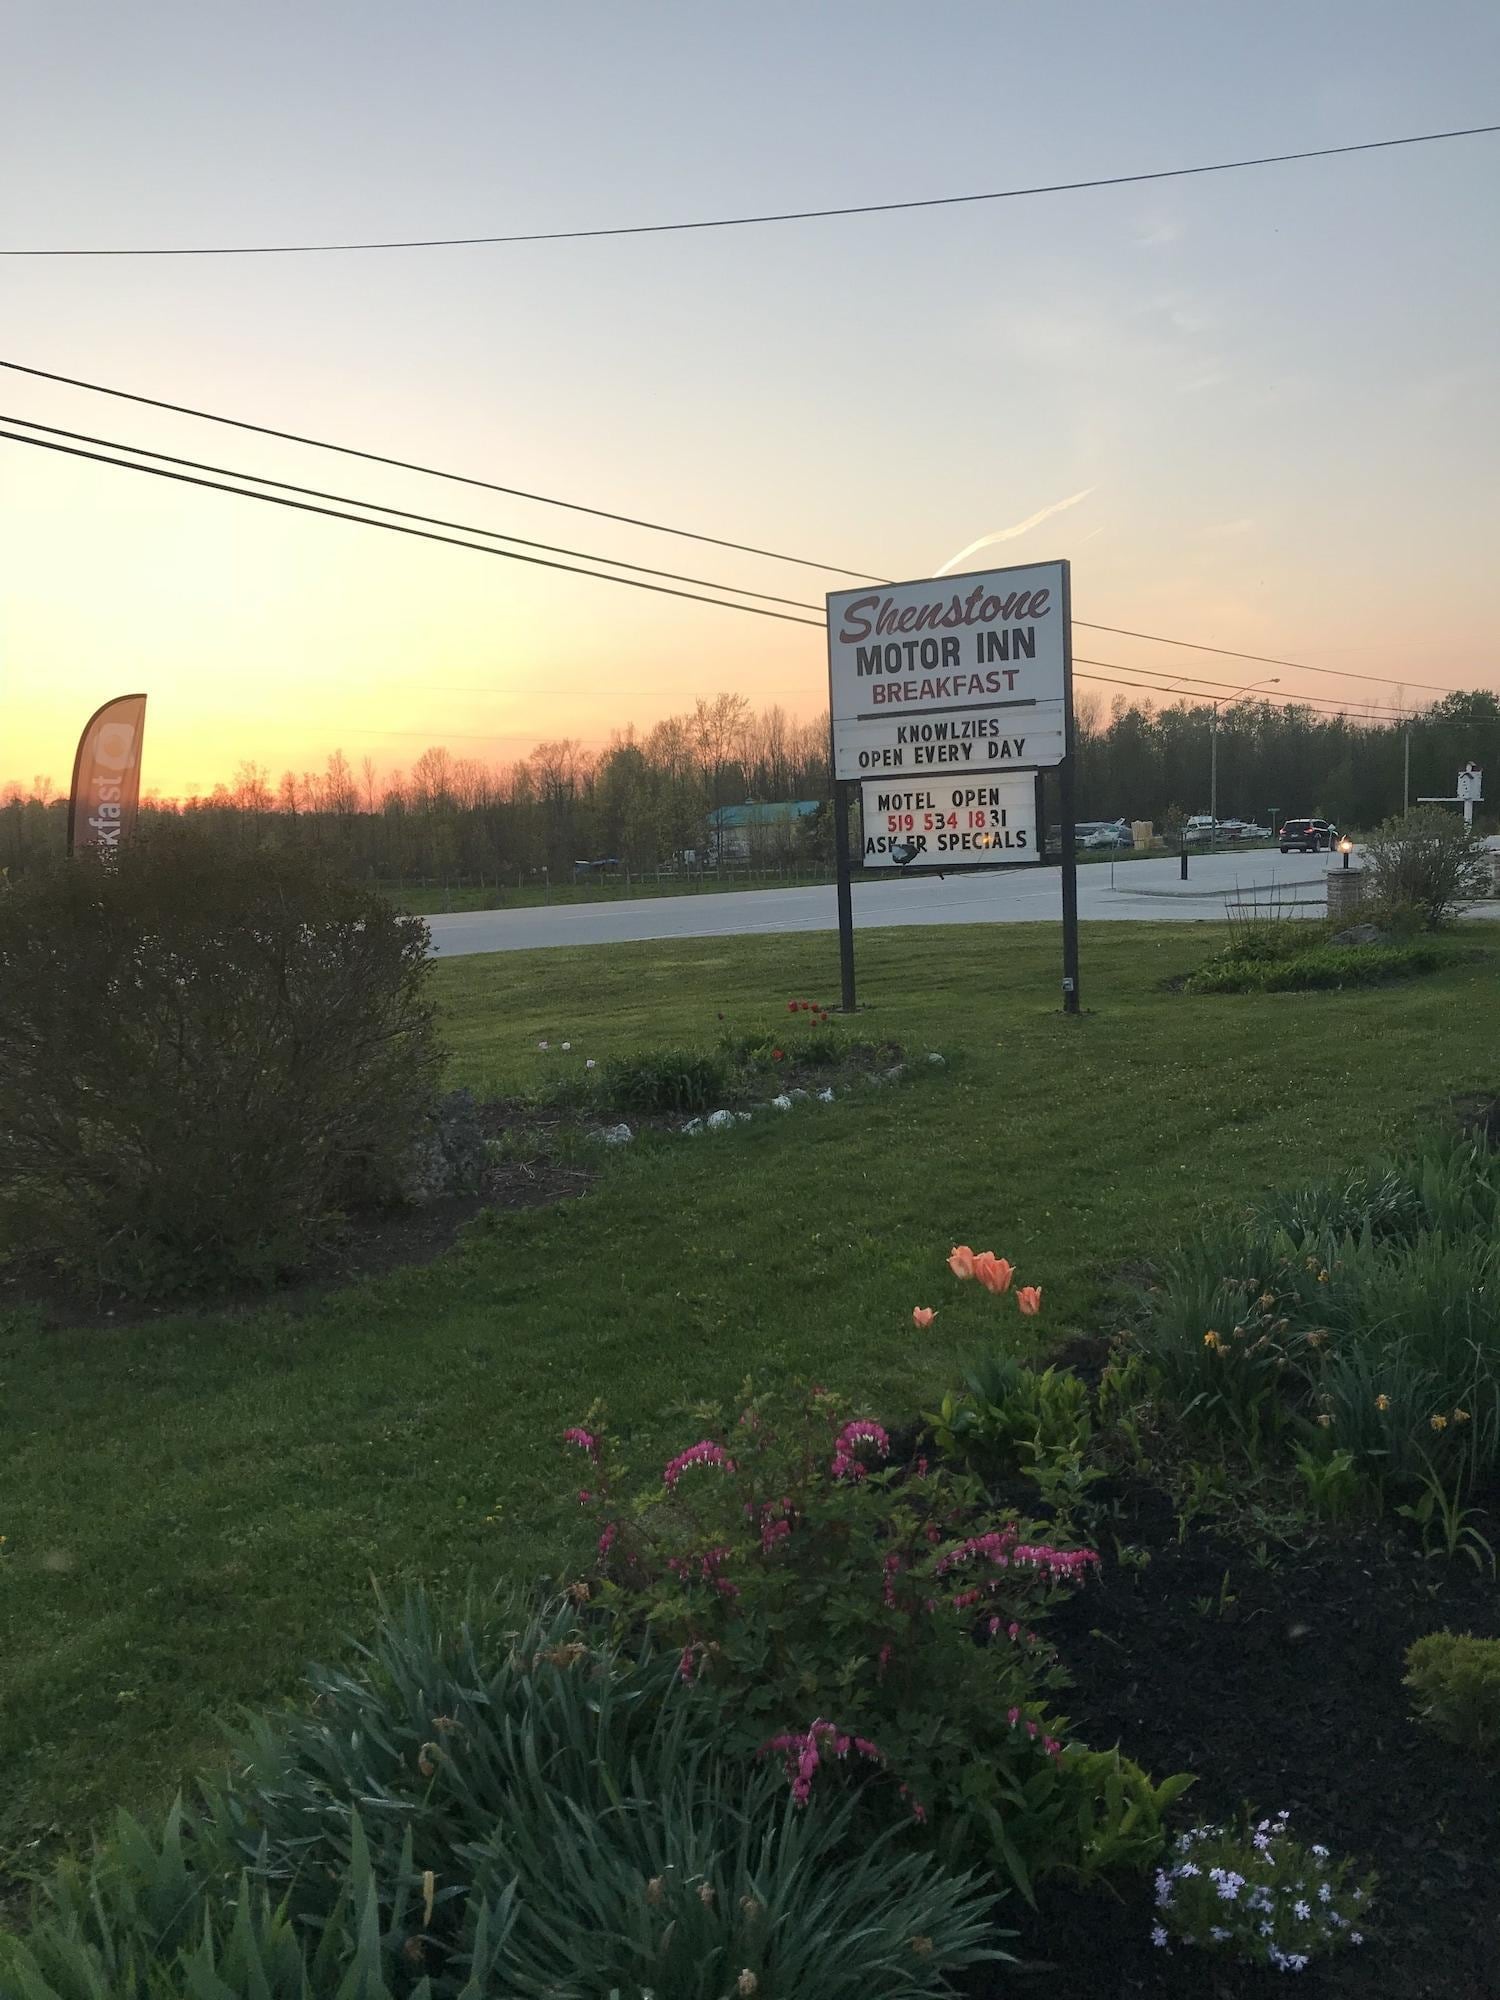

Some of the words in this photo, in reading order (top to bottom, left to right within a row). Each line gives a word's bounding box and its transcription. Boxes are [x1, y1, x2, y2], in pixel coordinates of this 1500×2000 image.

[839, 585, 1051, 644] Shenstone
[856, 637, 960, 677] MOTOR
[977, 626, 1036, 664] INN
[872, 669, 1020, 705] BREAKFAST
[897, 719, 1000, 744] KNOWLZIES
[858, 748, 903, 768] OPEN
[914, 742, 973, 764] EVERY
[988, 738, 1026, 759] DAY
[878, 792, 936, 811] MOTEL
[951, 788, 1000, 807] OPEN
[88, 775, 121, 878] kfast
[888, 814, 914, 832] 519
[924, 812, 958, 831] 534
[866, 836, 898, 854] ASK
[937, 830, 1027, 851] SPECIALS
